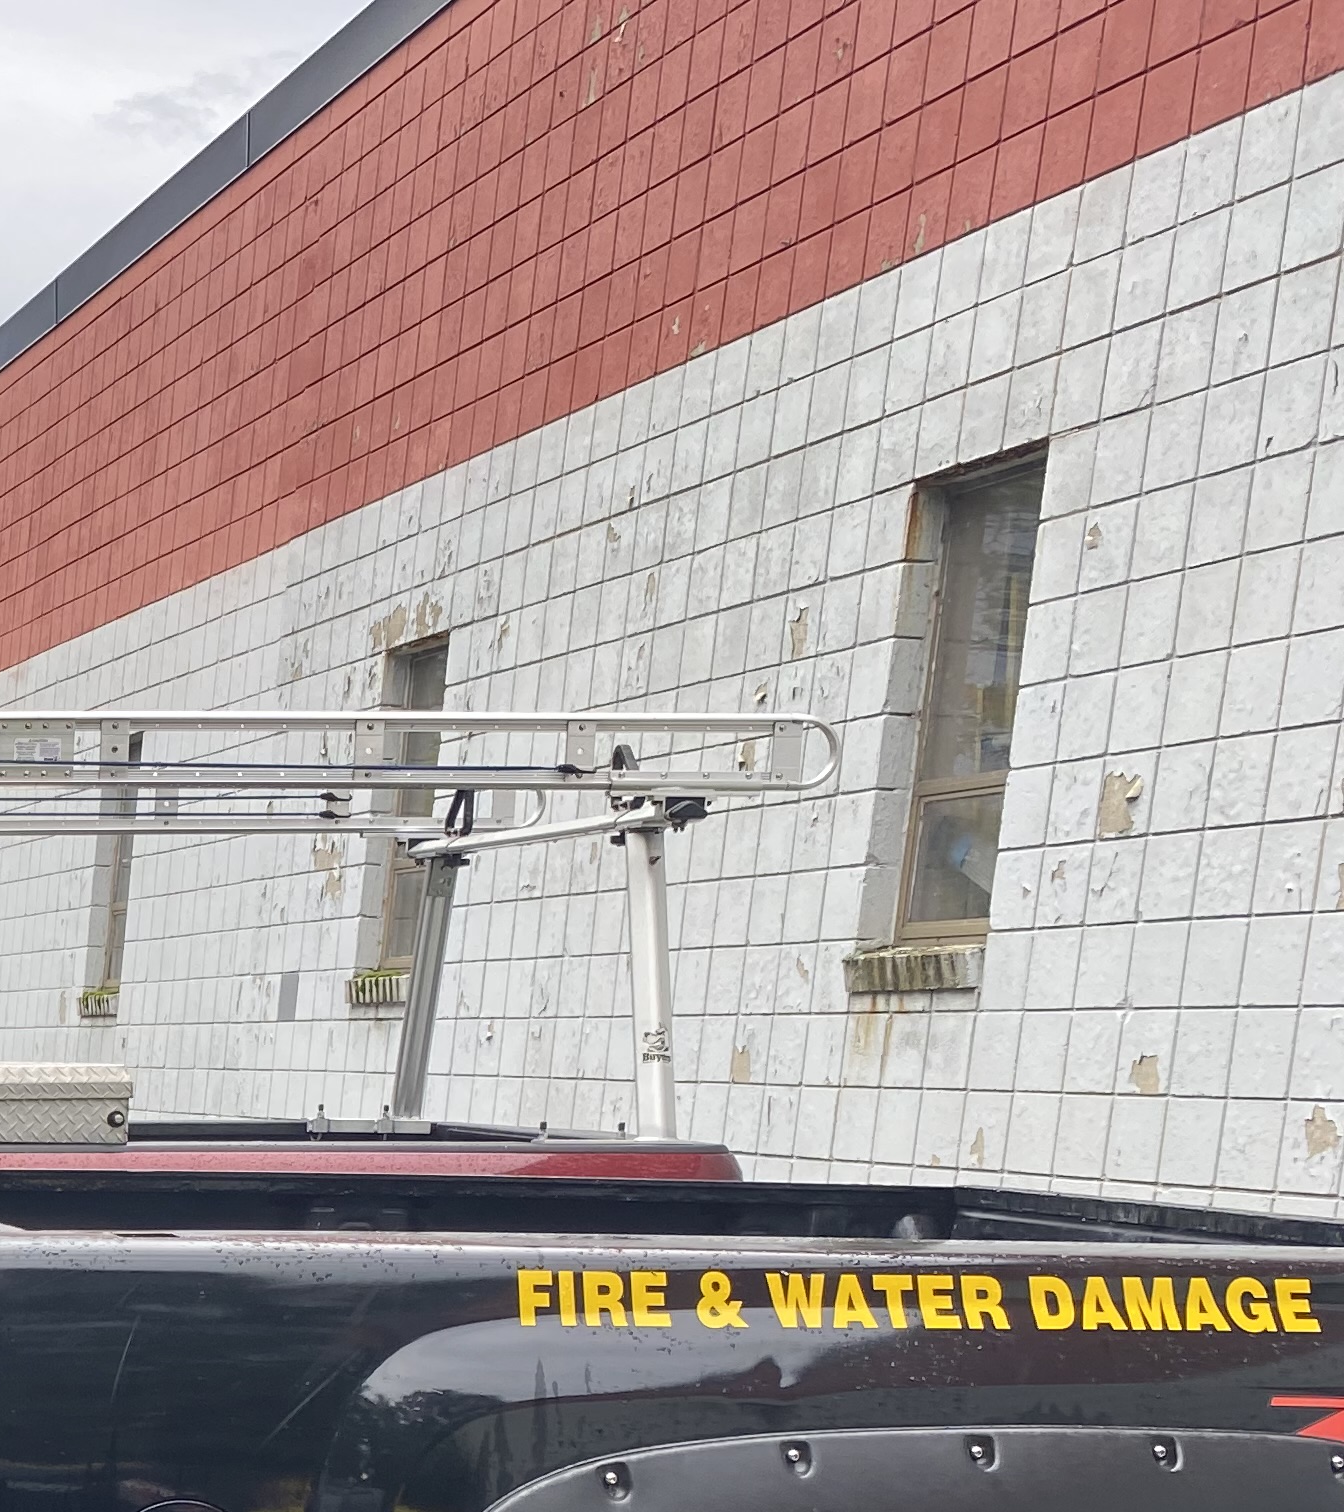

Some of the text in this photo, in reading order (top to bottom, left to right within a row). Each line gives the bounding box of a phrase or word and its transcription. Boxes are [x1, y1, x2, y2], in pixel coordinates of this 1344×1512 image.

[517, 1269, 1323, 1334] FIRE & WATER DAMAGE
